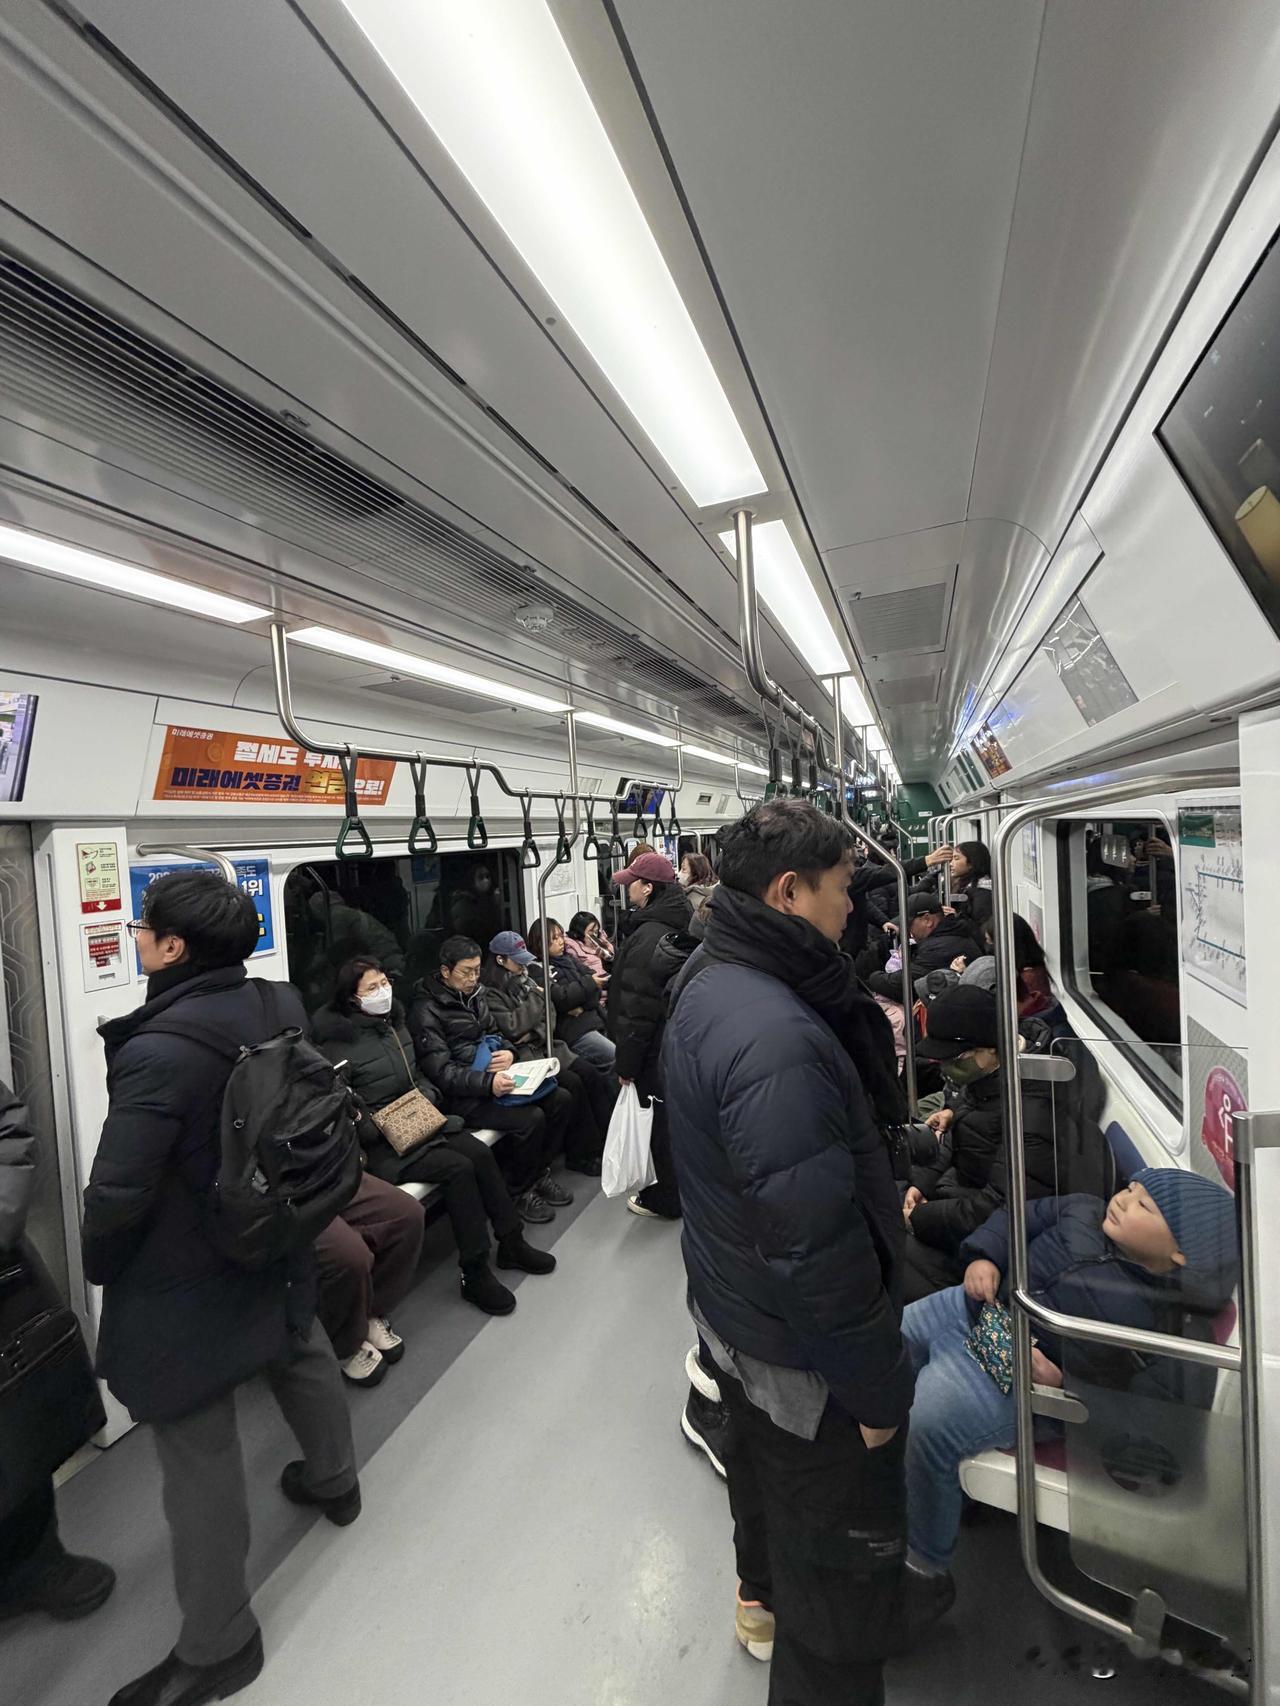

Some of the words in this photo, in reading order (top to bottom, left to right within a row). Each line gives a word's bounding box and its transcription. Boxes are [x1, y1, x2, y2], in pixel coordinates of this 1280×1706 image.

[171, 728, 214, 740] 미래에셋증권
[234, 740, 300, 766] 절세도
[170, 767, 302, 792] 미래에셋증권
